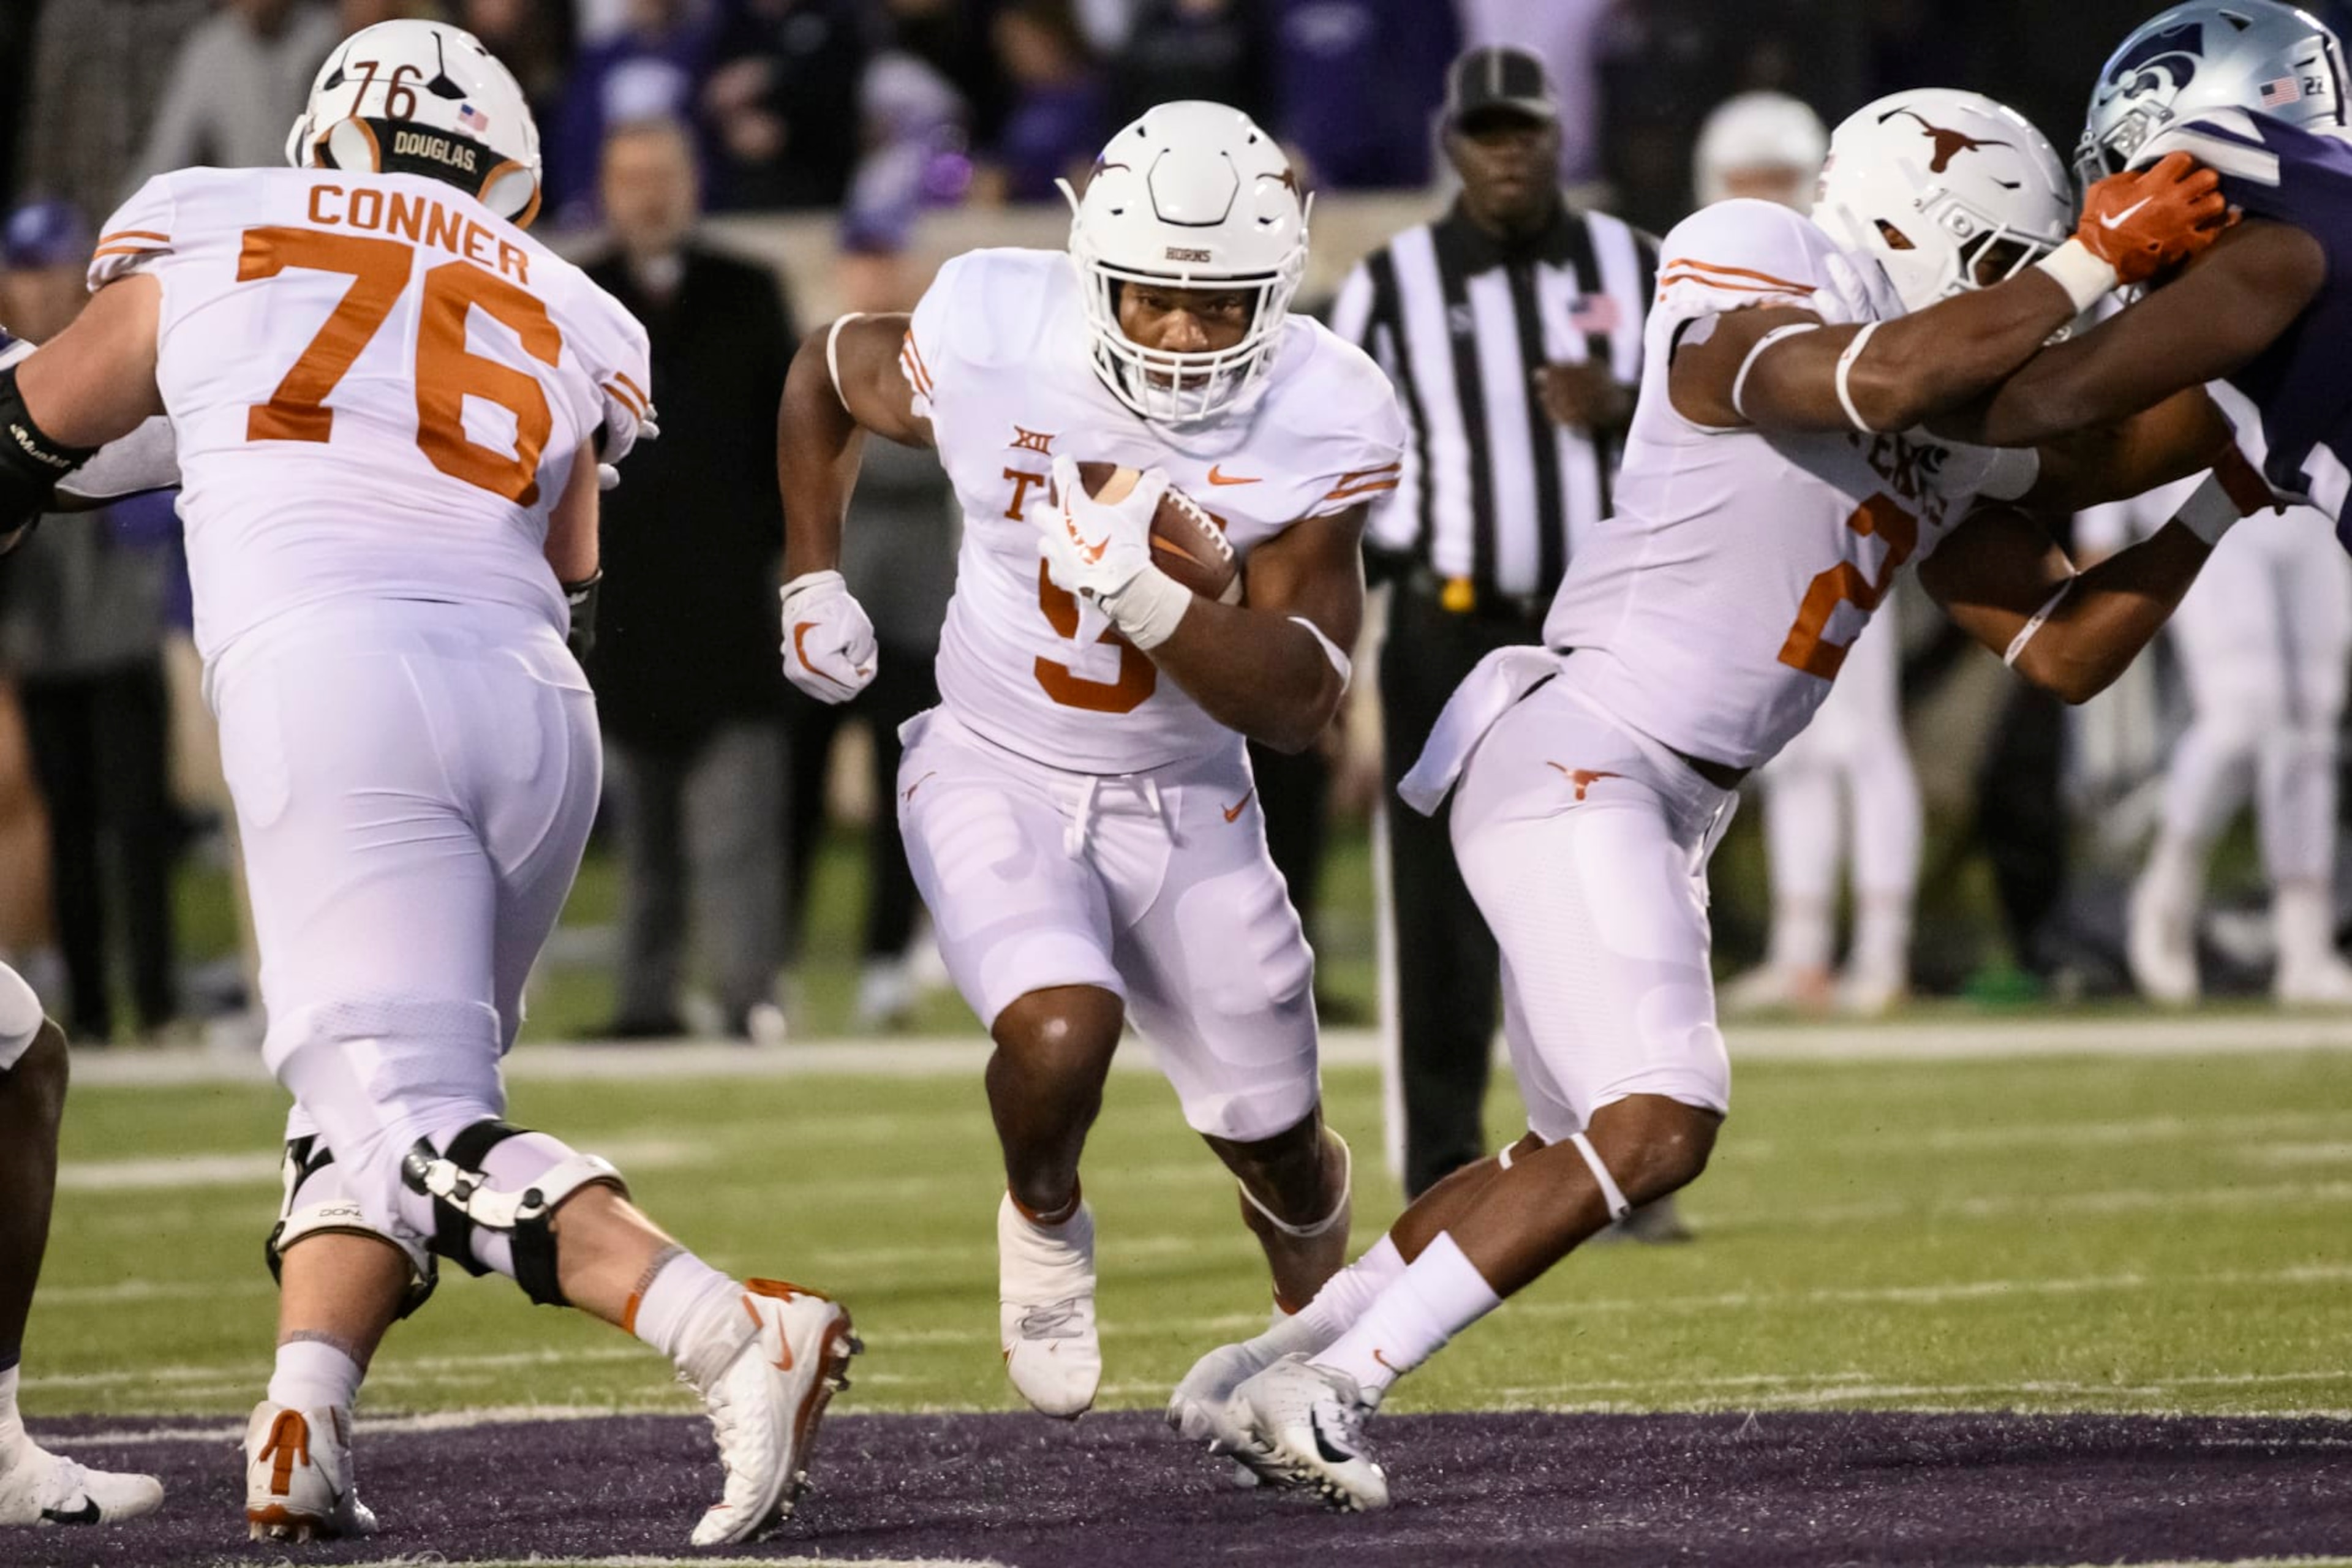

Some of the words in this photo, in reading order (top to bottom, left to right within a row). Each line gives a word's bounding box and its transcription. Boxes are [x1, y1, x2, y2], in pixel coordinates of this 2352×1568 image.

[352, 61, 423, 121] 76
[394, 130, 476, 172] DOUGLAS
[308, 184, 529, 285] CONNER
[1166, 246, 1211, 263] HORNS
[236, 225, 562, 508] 76
[1009, 424, 1056, 456] XII
[1777, 492, 1918, 681] 2
